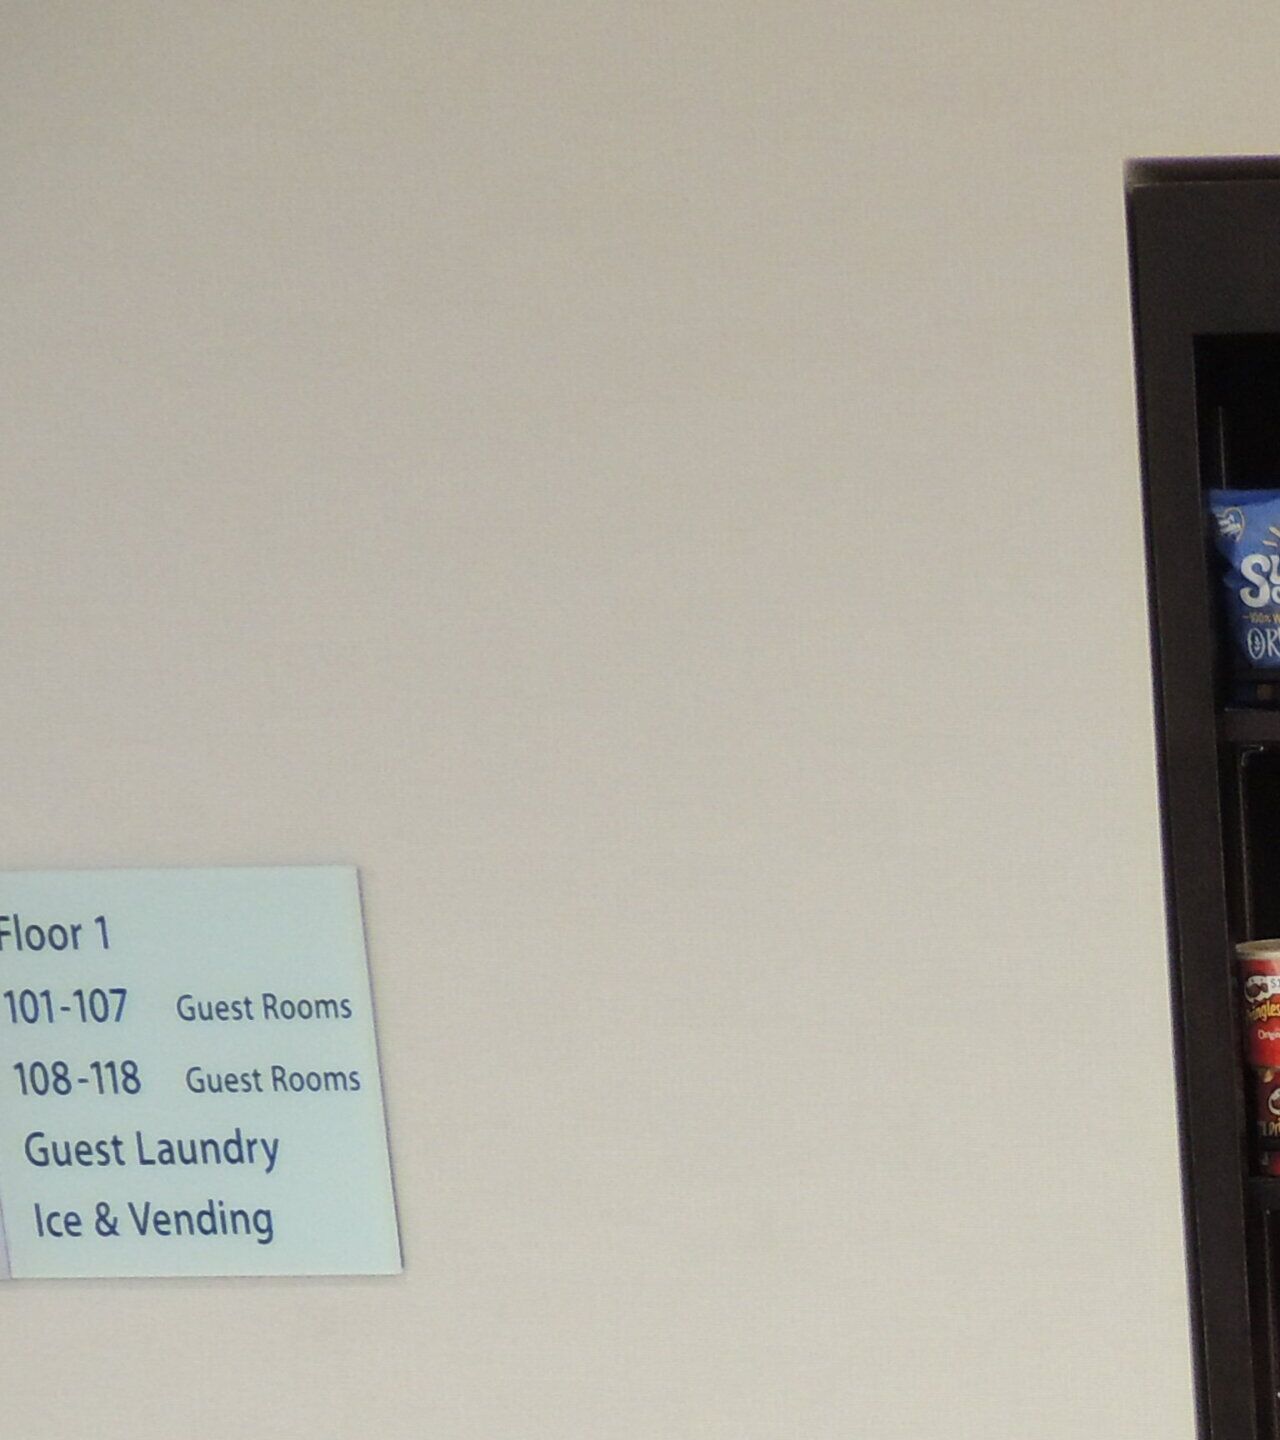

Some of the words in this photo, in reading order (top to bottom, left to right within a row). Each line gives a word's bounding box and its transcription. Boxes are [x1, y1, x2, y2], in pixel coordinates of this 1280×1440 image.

[94, 915, 109, 949] 1
[3, 988, 128, 1024] 101-107
[177, 994, 254, 1022] Guest
[262, 993, 352, 1021] Rooms
[13, 1060, 142, 1096] 108-118
[186, 1067, 262, 1093] Guest
[271, 1065, 361, 1092] Rooms
[24, 1132, 126, 1167] Guest
[136, 1128, 279, 1174] Laundry
[34, 1203, 83, 1237] Ice
[95, 1202, 120, 1237] &
[128, 1200, 275, 1245] Vending
